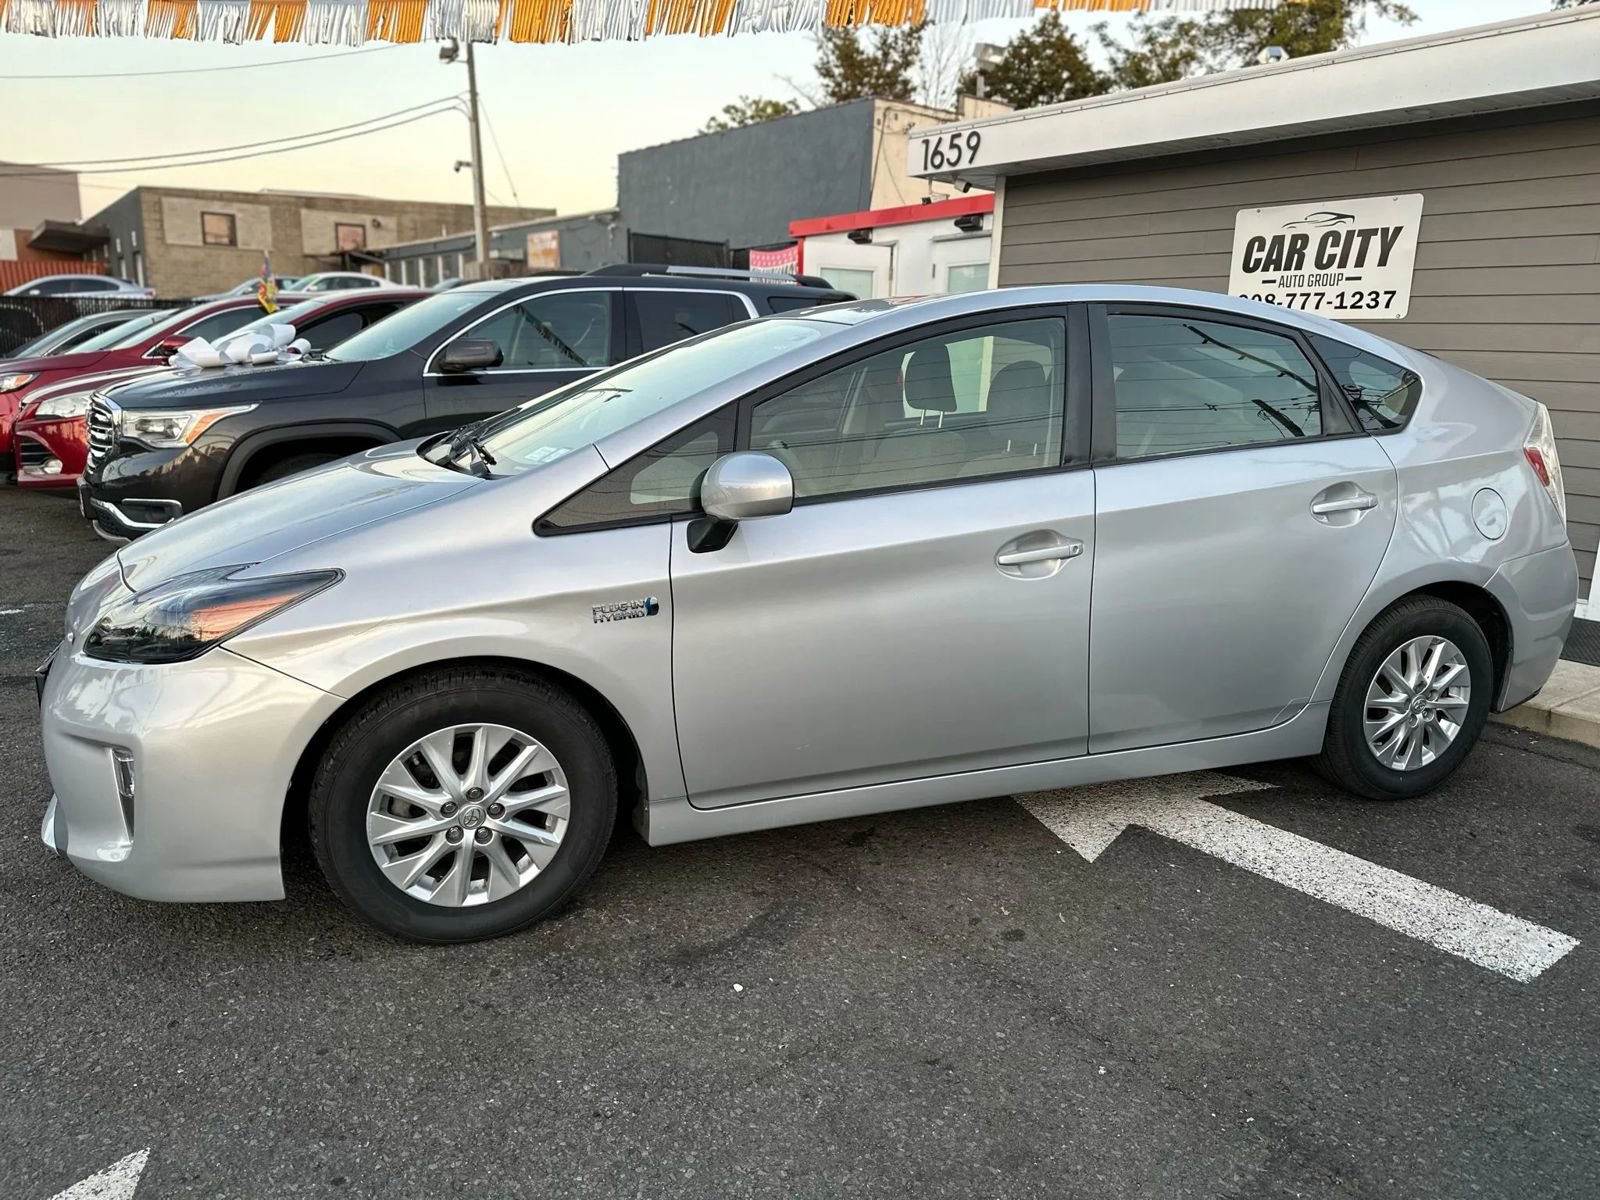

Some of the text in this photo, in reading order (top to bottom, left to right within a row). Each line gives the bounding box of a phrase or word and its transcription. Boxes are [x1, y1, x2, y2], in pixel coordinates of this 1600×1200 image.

[921, 130, 981, 171] 1659
[1242, 225, 1404, 274] CAR CITY
[1278, 272, 1344, 289] AUTO GROUP
[1238, 290, 1397, 310] 8-777-1237
[593, 610, 645, 624] HYBRID
